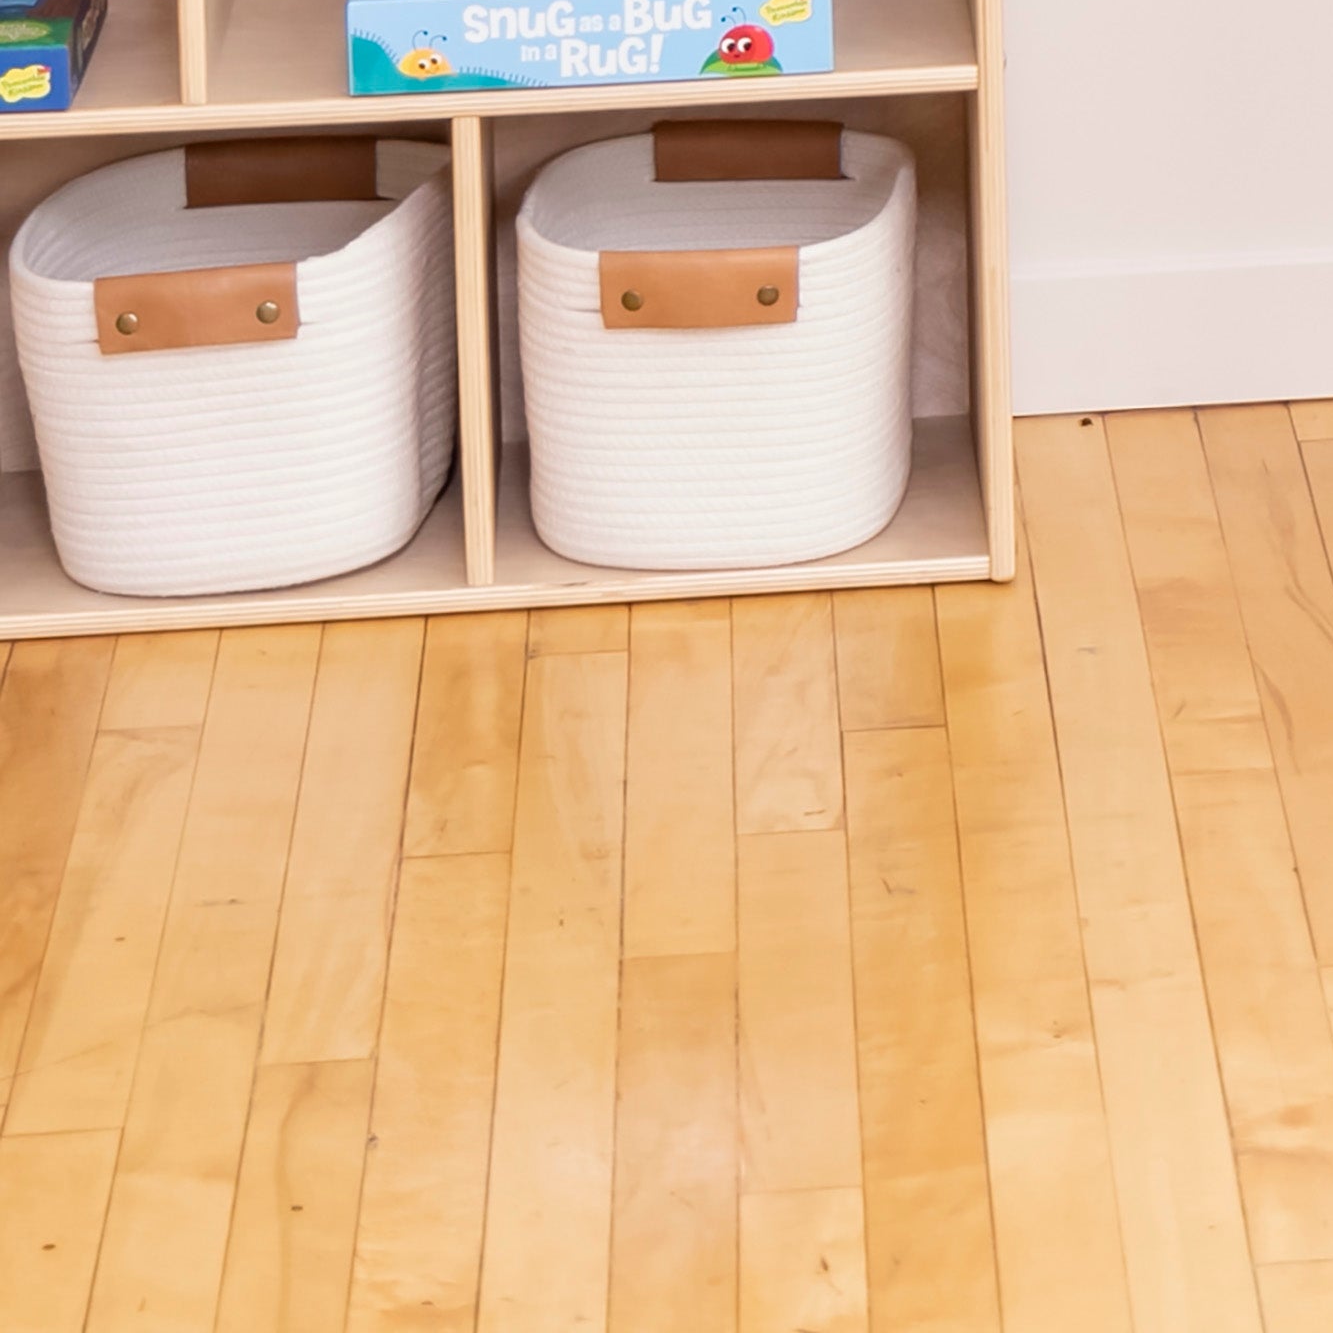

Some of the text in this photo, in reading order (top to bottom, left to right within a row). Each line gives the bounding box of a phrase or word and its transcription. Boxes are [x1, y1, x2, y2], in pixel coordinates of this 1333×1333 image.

[579, 14, 603, 32] as
[609, 15, 621, 31] a
[545, 44, 556, 60] a
